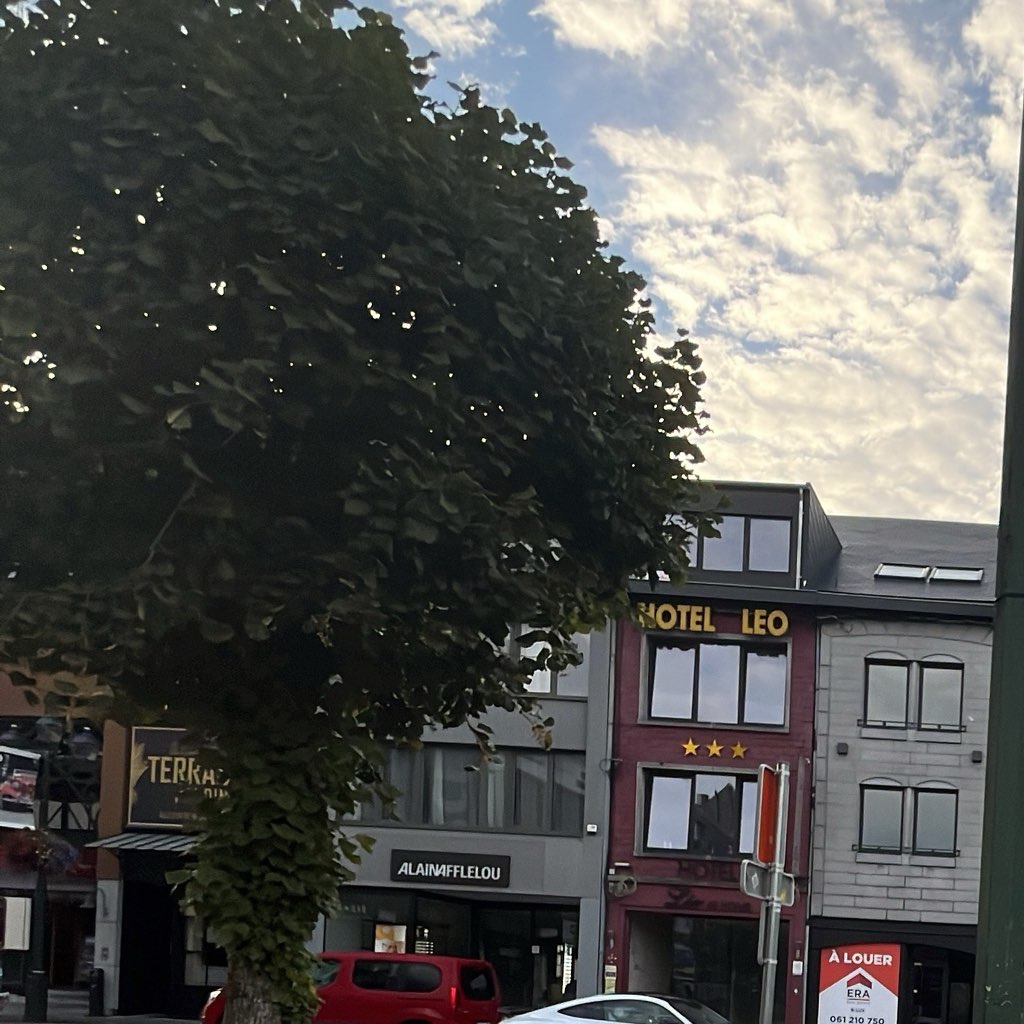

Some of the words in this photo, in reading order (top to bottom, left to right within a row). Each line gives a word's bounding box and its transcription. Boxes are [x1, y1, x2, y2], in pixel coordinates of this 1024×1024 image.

[638, 602, 716, 632] HOTEL
[741, 608, 789, 637] LEO
[828, 949, 840, 963] À
[843, 952, 893, 966] LOUER
[847, 989, 870, 998] ERA
[829, 1015, 846, 1023] 061
[848, 1016, 865, 1024] 210
